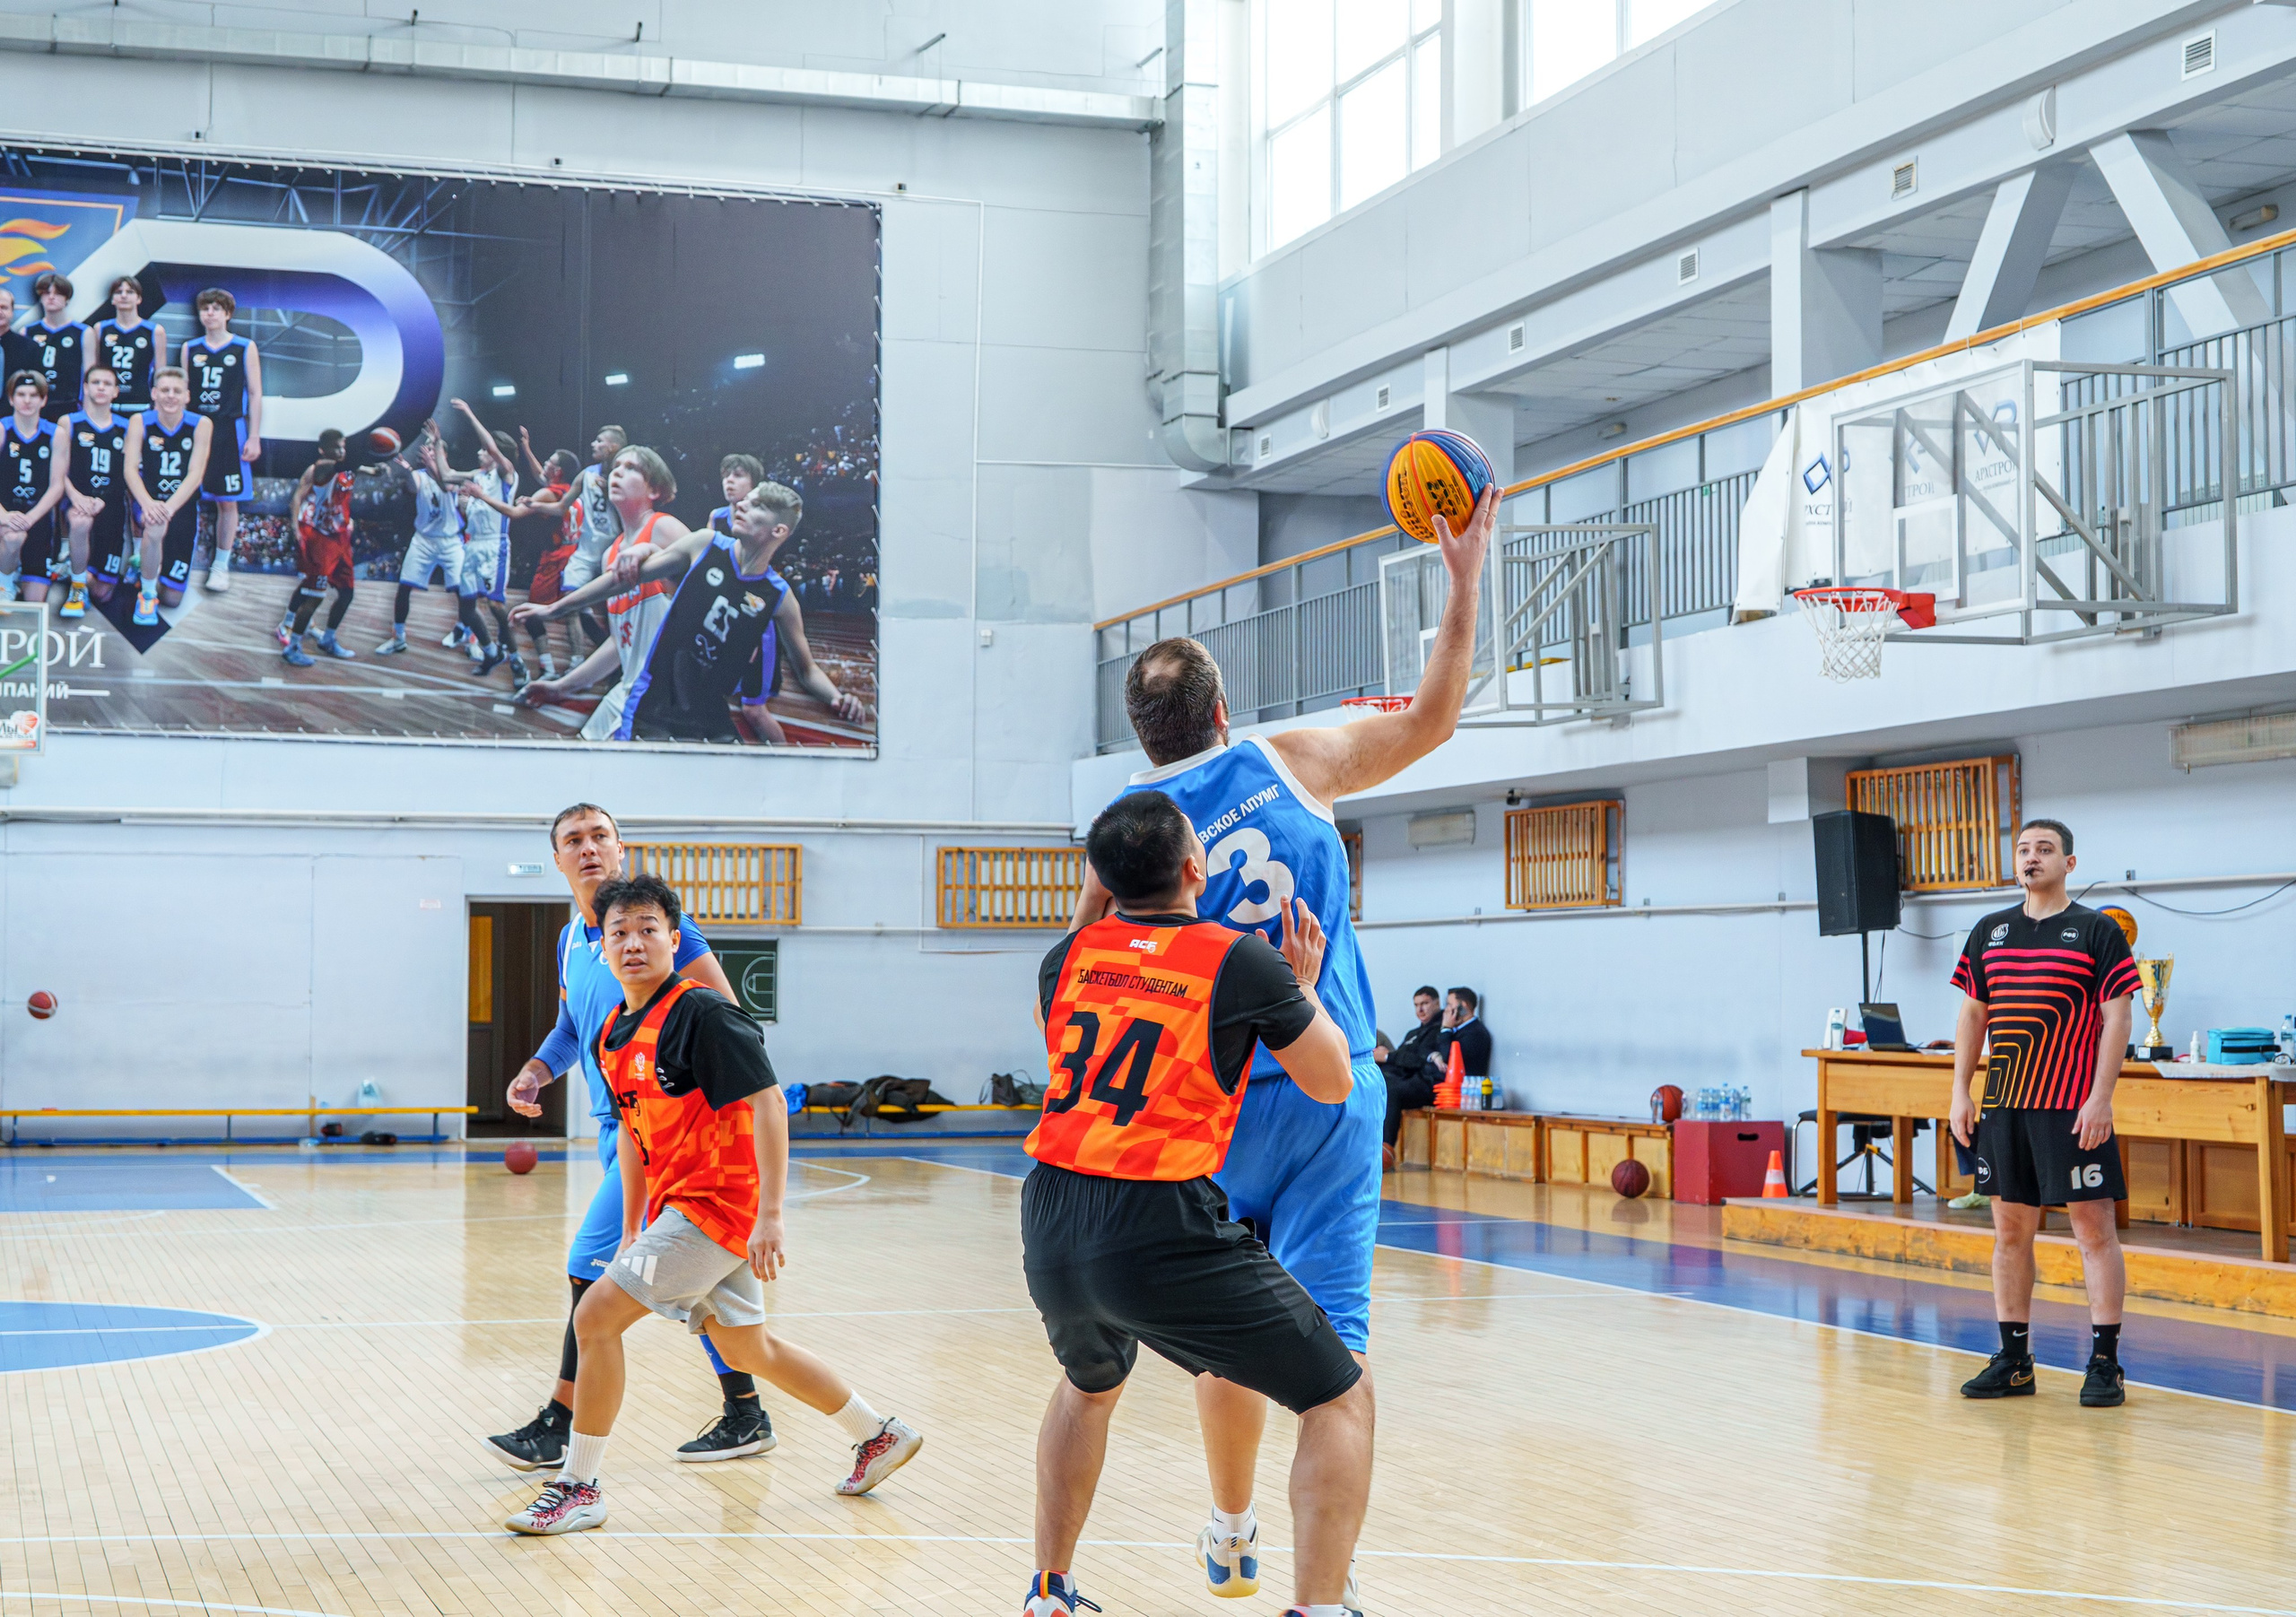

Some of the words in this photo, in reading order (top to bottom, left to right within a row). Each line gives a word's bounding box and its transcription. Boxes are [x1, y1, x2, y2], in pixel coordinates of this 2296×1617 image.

[111, 345, 135, 369] 22
[202, 366, 223, 388] 15
[19, 458, 32, 483] 5
[91, 447, 111, 474] 19
[160, 451, 181, 476] 12
[1975, 459, 2016, 482] АРХСТРО
[225, 474, 240, 492] 15
[104, 553, 121, 574] 19
[170, 560, 188, 581] 12
[1239, 784, 1280, 817] ЛПУМГ
[1206, 827, 1294, 925] 3
[1077, 969, 1130, 988] БАСКЕТБОЛ
[1129, 975, 1189, 999] СТУДЕНТАМ
[1044, 1011, 1165, 1126] 34
[2070, 1163, 2104, 1190] 16
